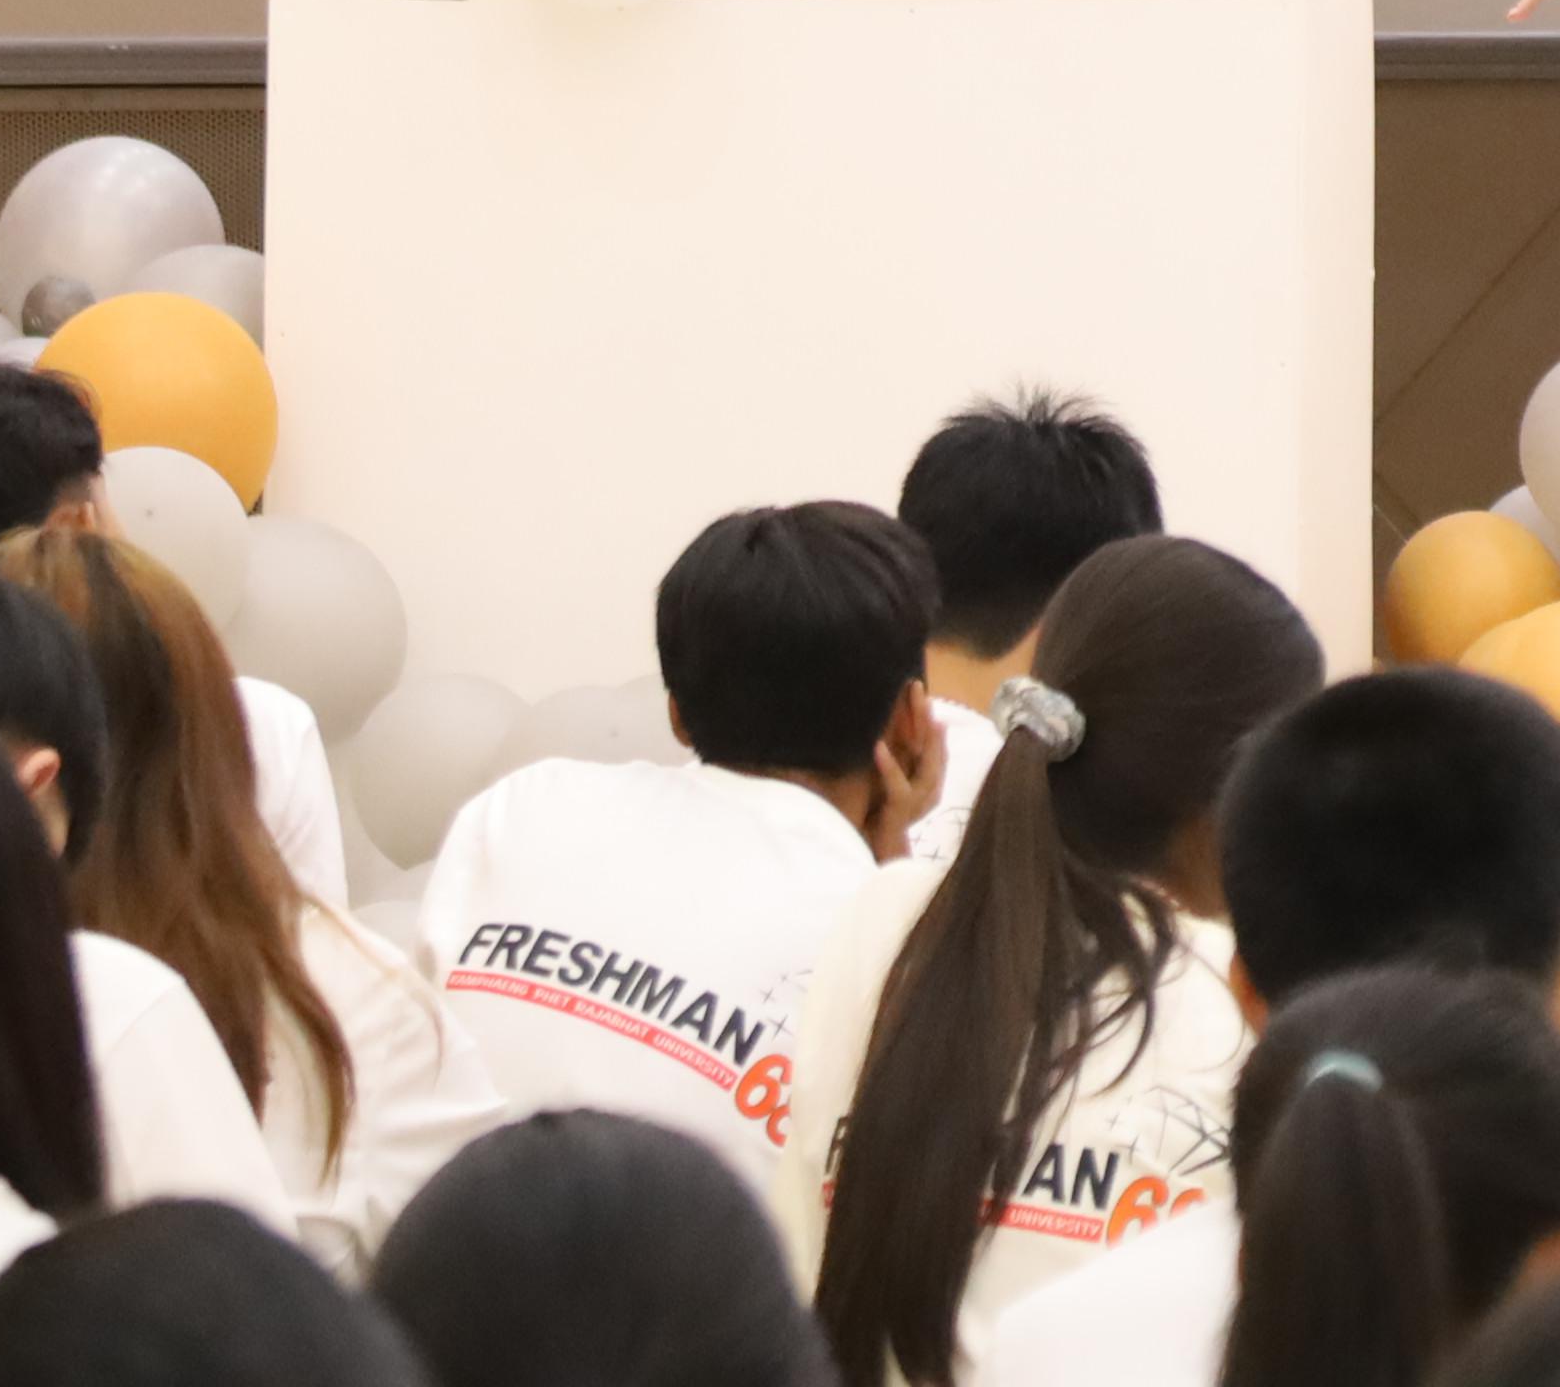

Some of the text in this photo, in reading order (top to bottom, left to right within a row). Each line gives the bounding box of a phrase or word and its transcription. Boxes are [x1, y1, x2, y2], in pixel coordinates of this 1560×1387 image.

[457, 923, 766, 1067] FRESHMAN
[652, 1032, 734, 1086] UNIVERSITY
[1009, 1208, 1101, 1237] UNIVERSITY
